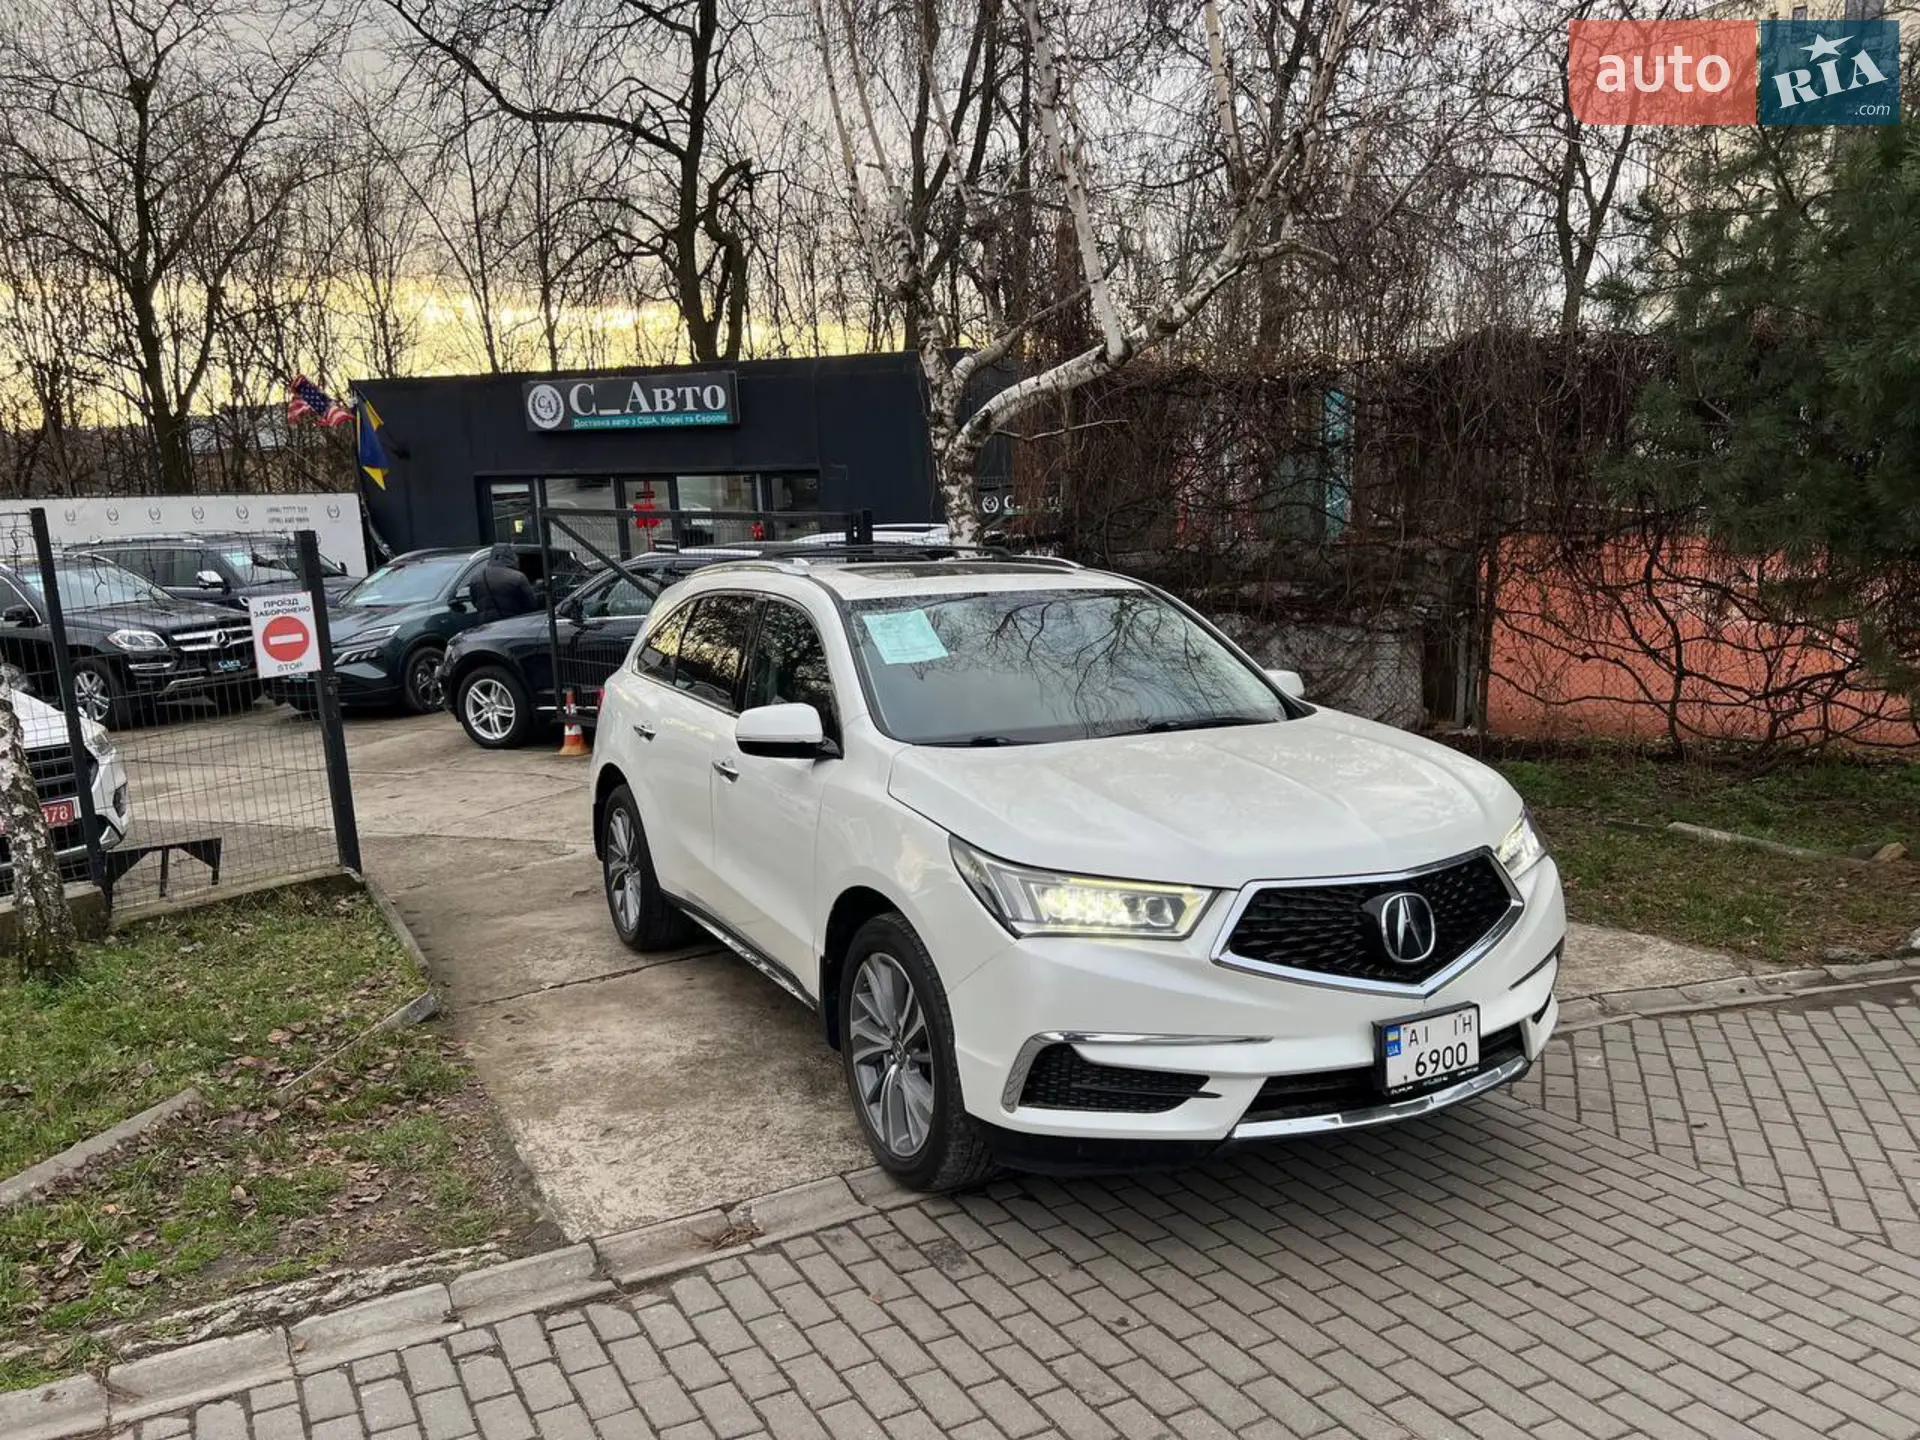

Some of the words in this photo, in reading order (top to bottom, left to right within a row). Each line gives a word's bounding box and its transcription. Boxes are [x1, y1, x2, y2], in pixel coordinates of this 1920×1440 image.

[573, 418, 610, 429] Доставка
[611, 418, 630, 426] авто
[684, 415, 694, 424] та
[263, 597, 299, 608] ПРОЇЗД
[253, 605, 311, 618] ЗАБОРОНЕНО
[276, 662, 303, 672] STOP
[1408, 1026, 1429, 1048] AI
[1454, 1014, 1473, 1036] IH
[1386, 1043, 1400, 1056] UA
[1415, 1042, 1468, 1077] 6900
